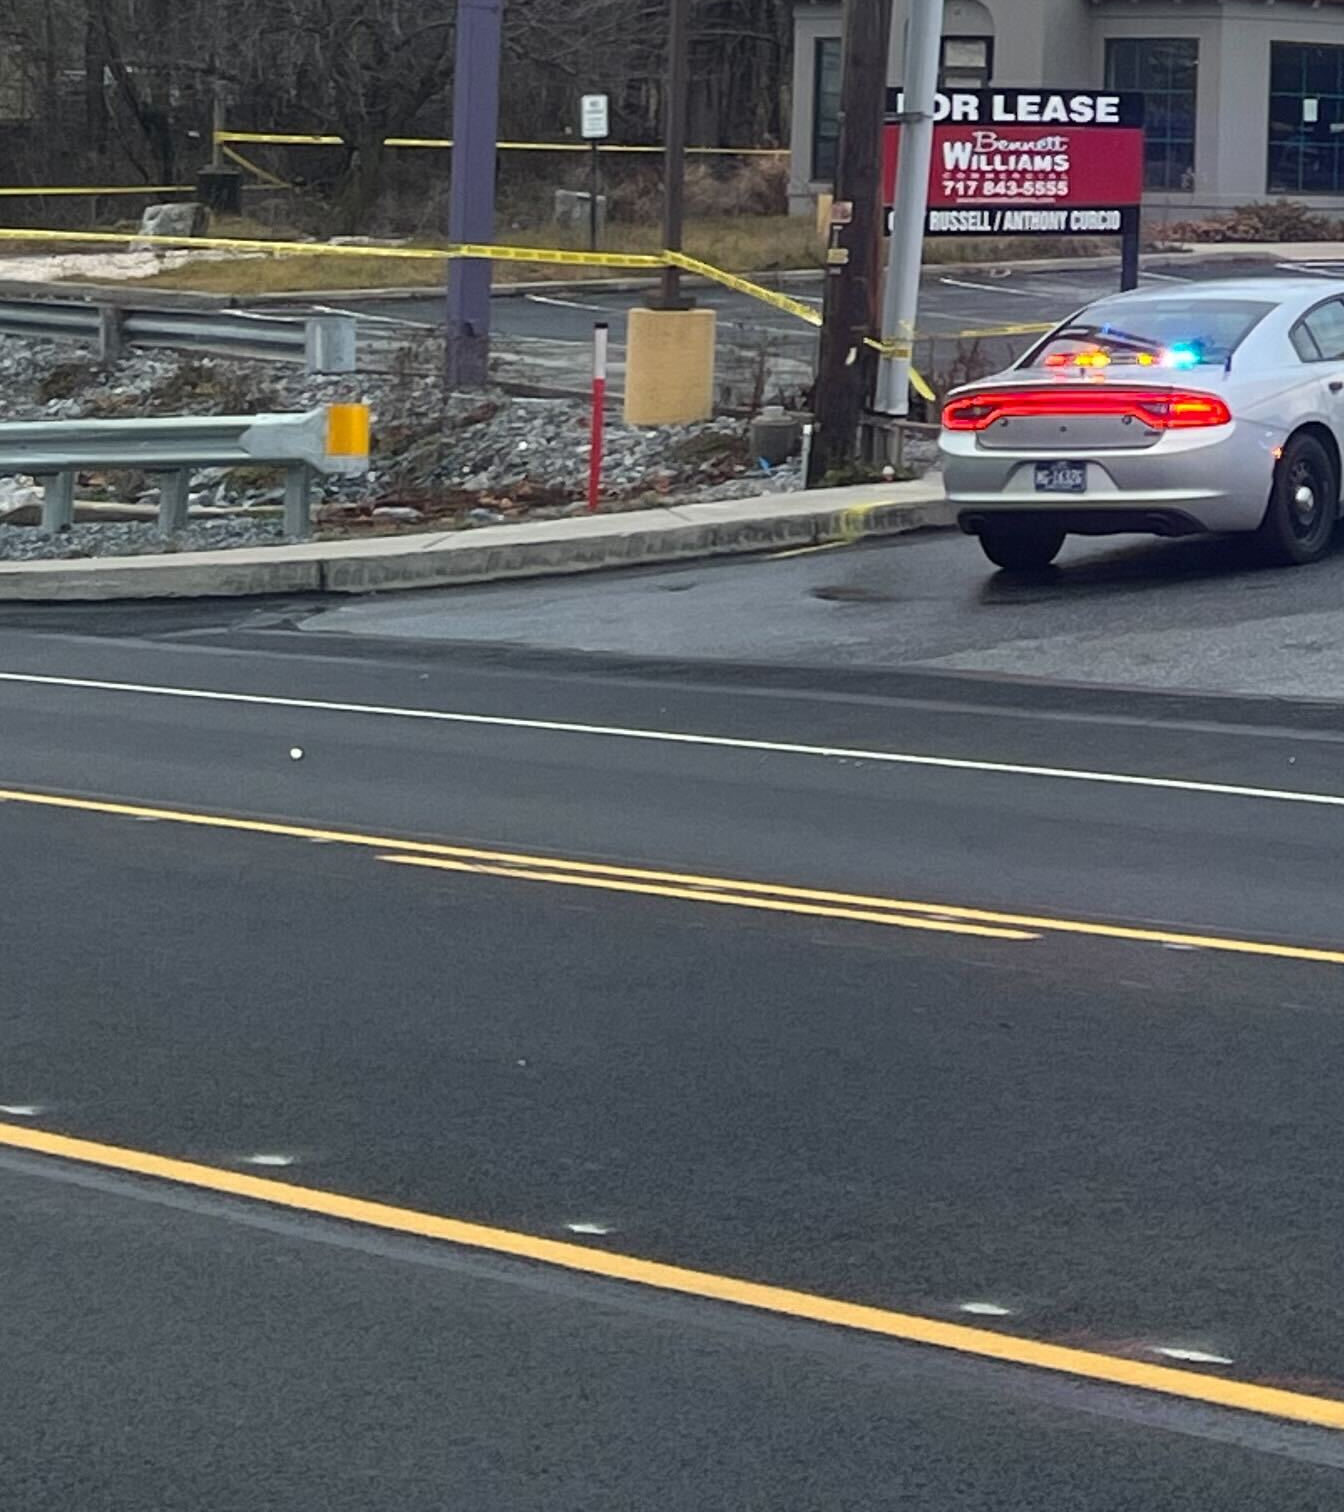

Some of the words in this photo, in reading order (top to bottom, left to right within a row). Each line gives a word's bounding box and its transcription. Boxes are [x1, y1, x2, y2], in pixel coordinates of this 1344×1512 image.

[897, 93, 979, 121] OR
[992, 94, 1120, 123] LEASE
[972, 131, 1070, 153] Bennett
[943, 141, 1070, 172] WILLIAMS
[942, 180, 978, 196] 717
[983, 180, 1069, 197] 843-5555
[929, 210, 991, 232] RUSSELL
